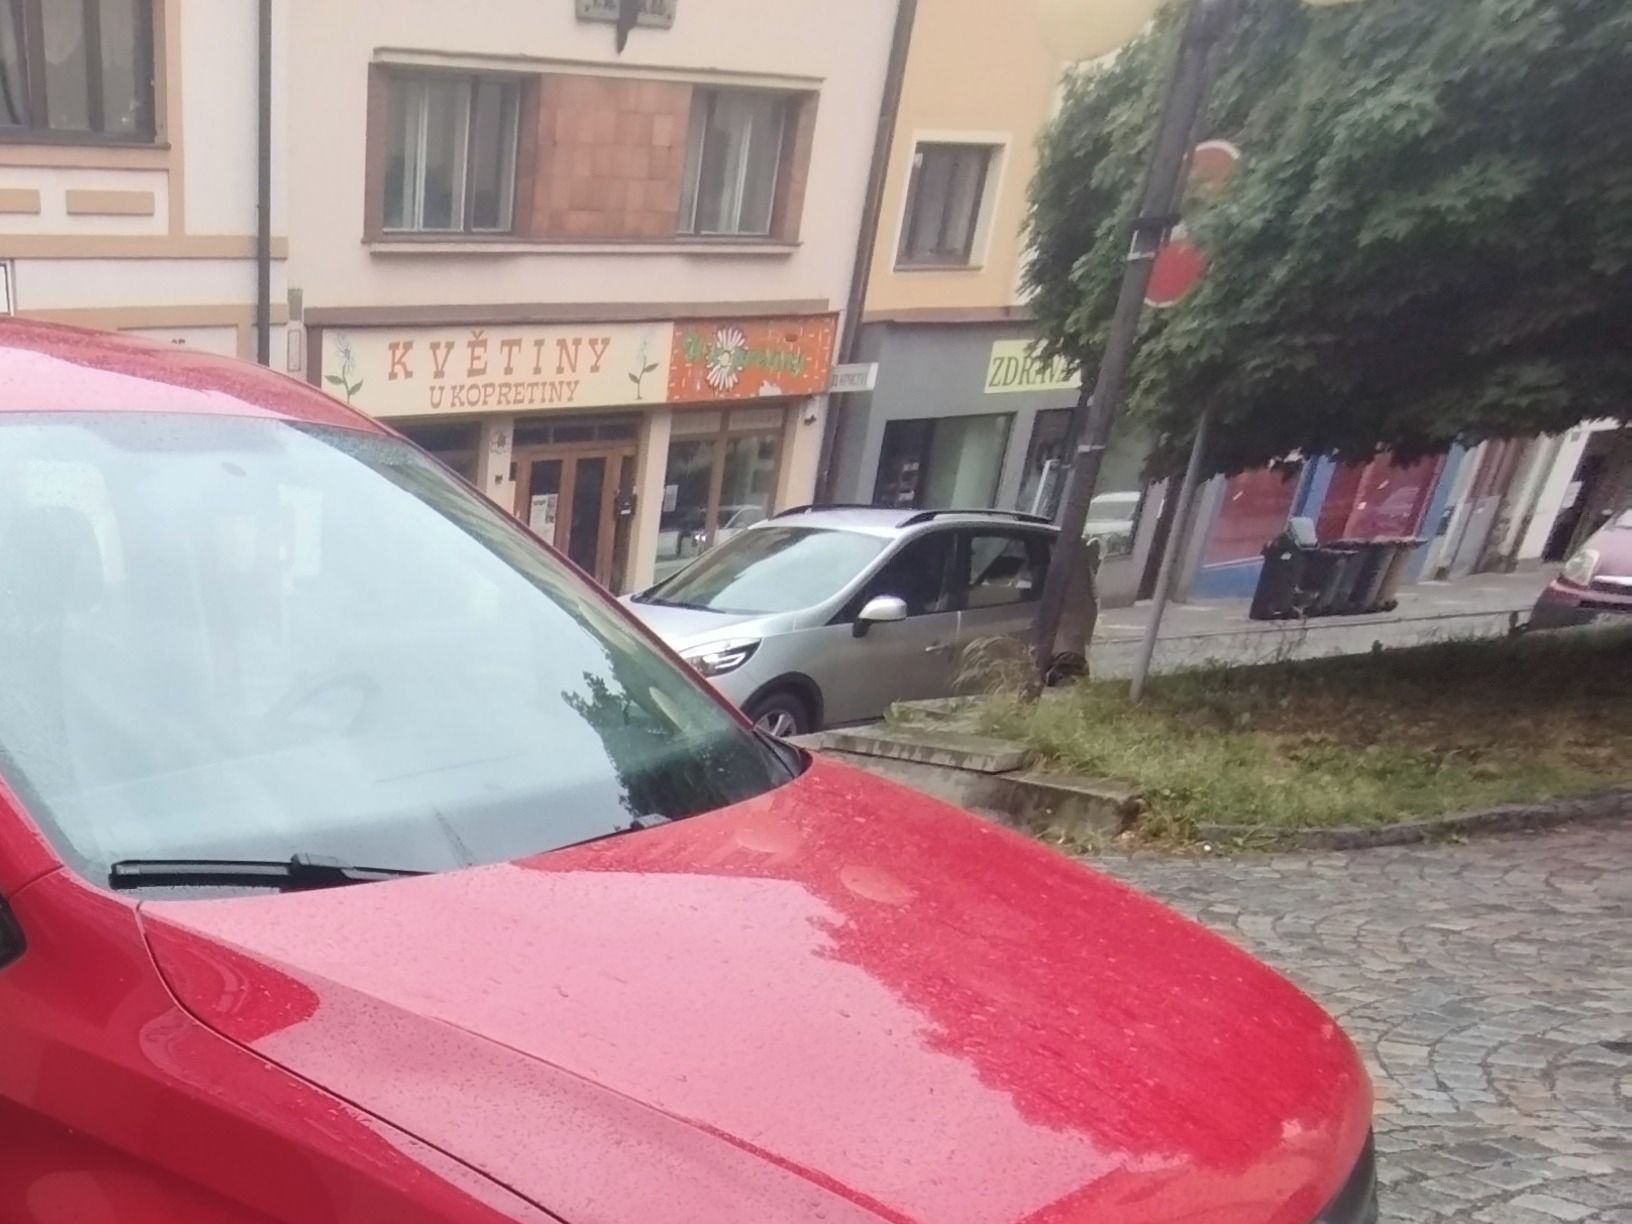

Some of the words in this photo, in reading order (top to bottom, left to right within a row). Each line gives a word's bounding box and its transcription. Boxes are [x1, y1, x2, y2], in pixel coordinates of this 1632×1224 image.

[388, 330, 611, 380] KVĚTINY
[429, 386, 447, 409] U
[450, 380, 580, 408] KOPRETINY
